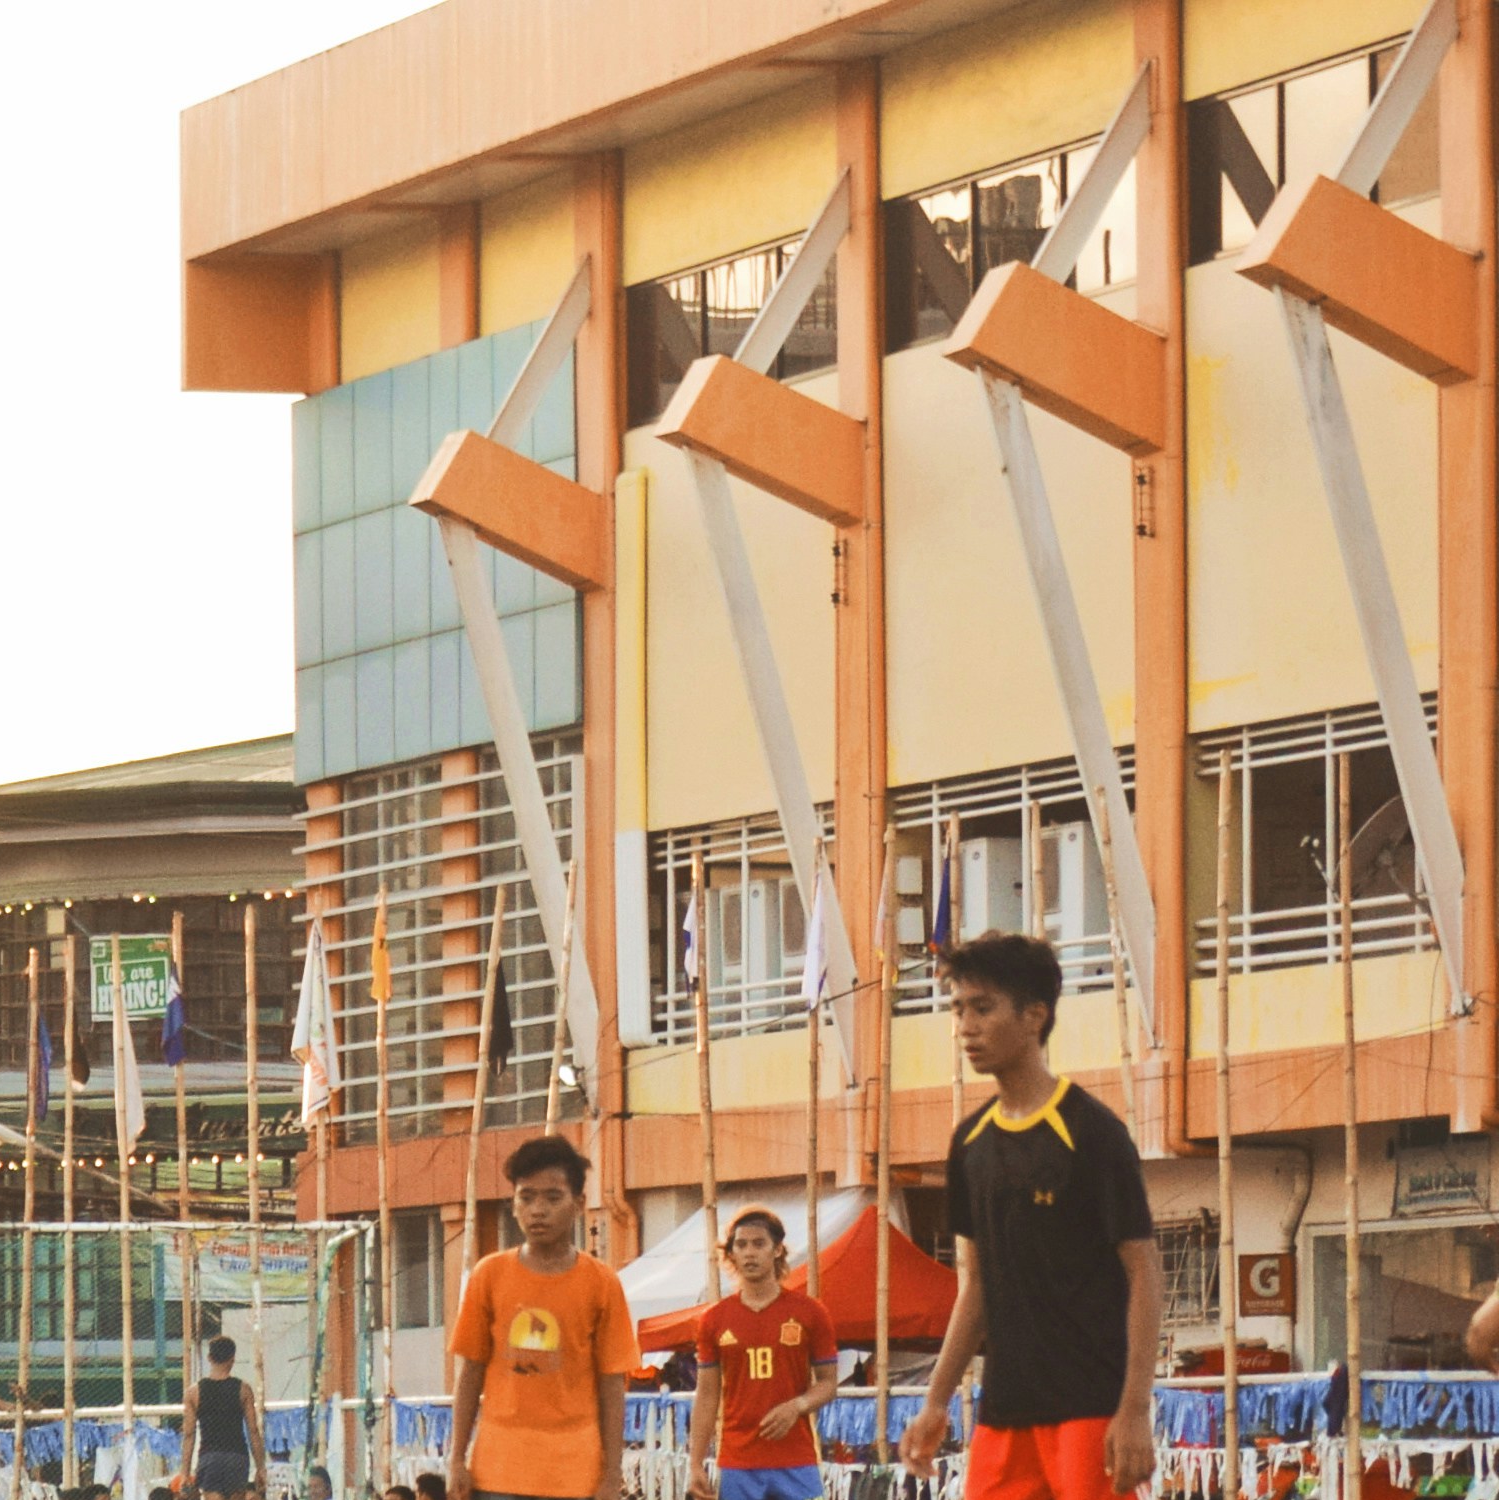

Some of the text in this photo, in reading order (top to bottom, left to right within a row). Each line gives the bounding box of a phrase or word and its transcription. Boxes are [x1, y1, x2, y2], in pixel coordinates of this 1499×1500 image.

[130, 966, 154, 980] are
[98, 979, 165, 1013] HRING!
[1250, 1258, 1280, 1298] G
[746, 1347, 773, 1379] 18
